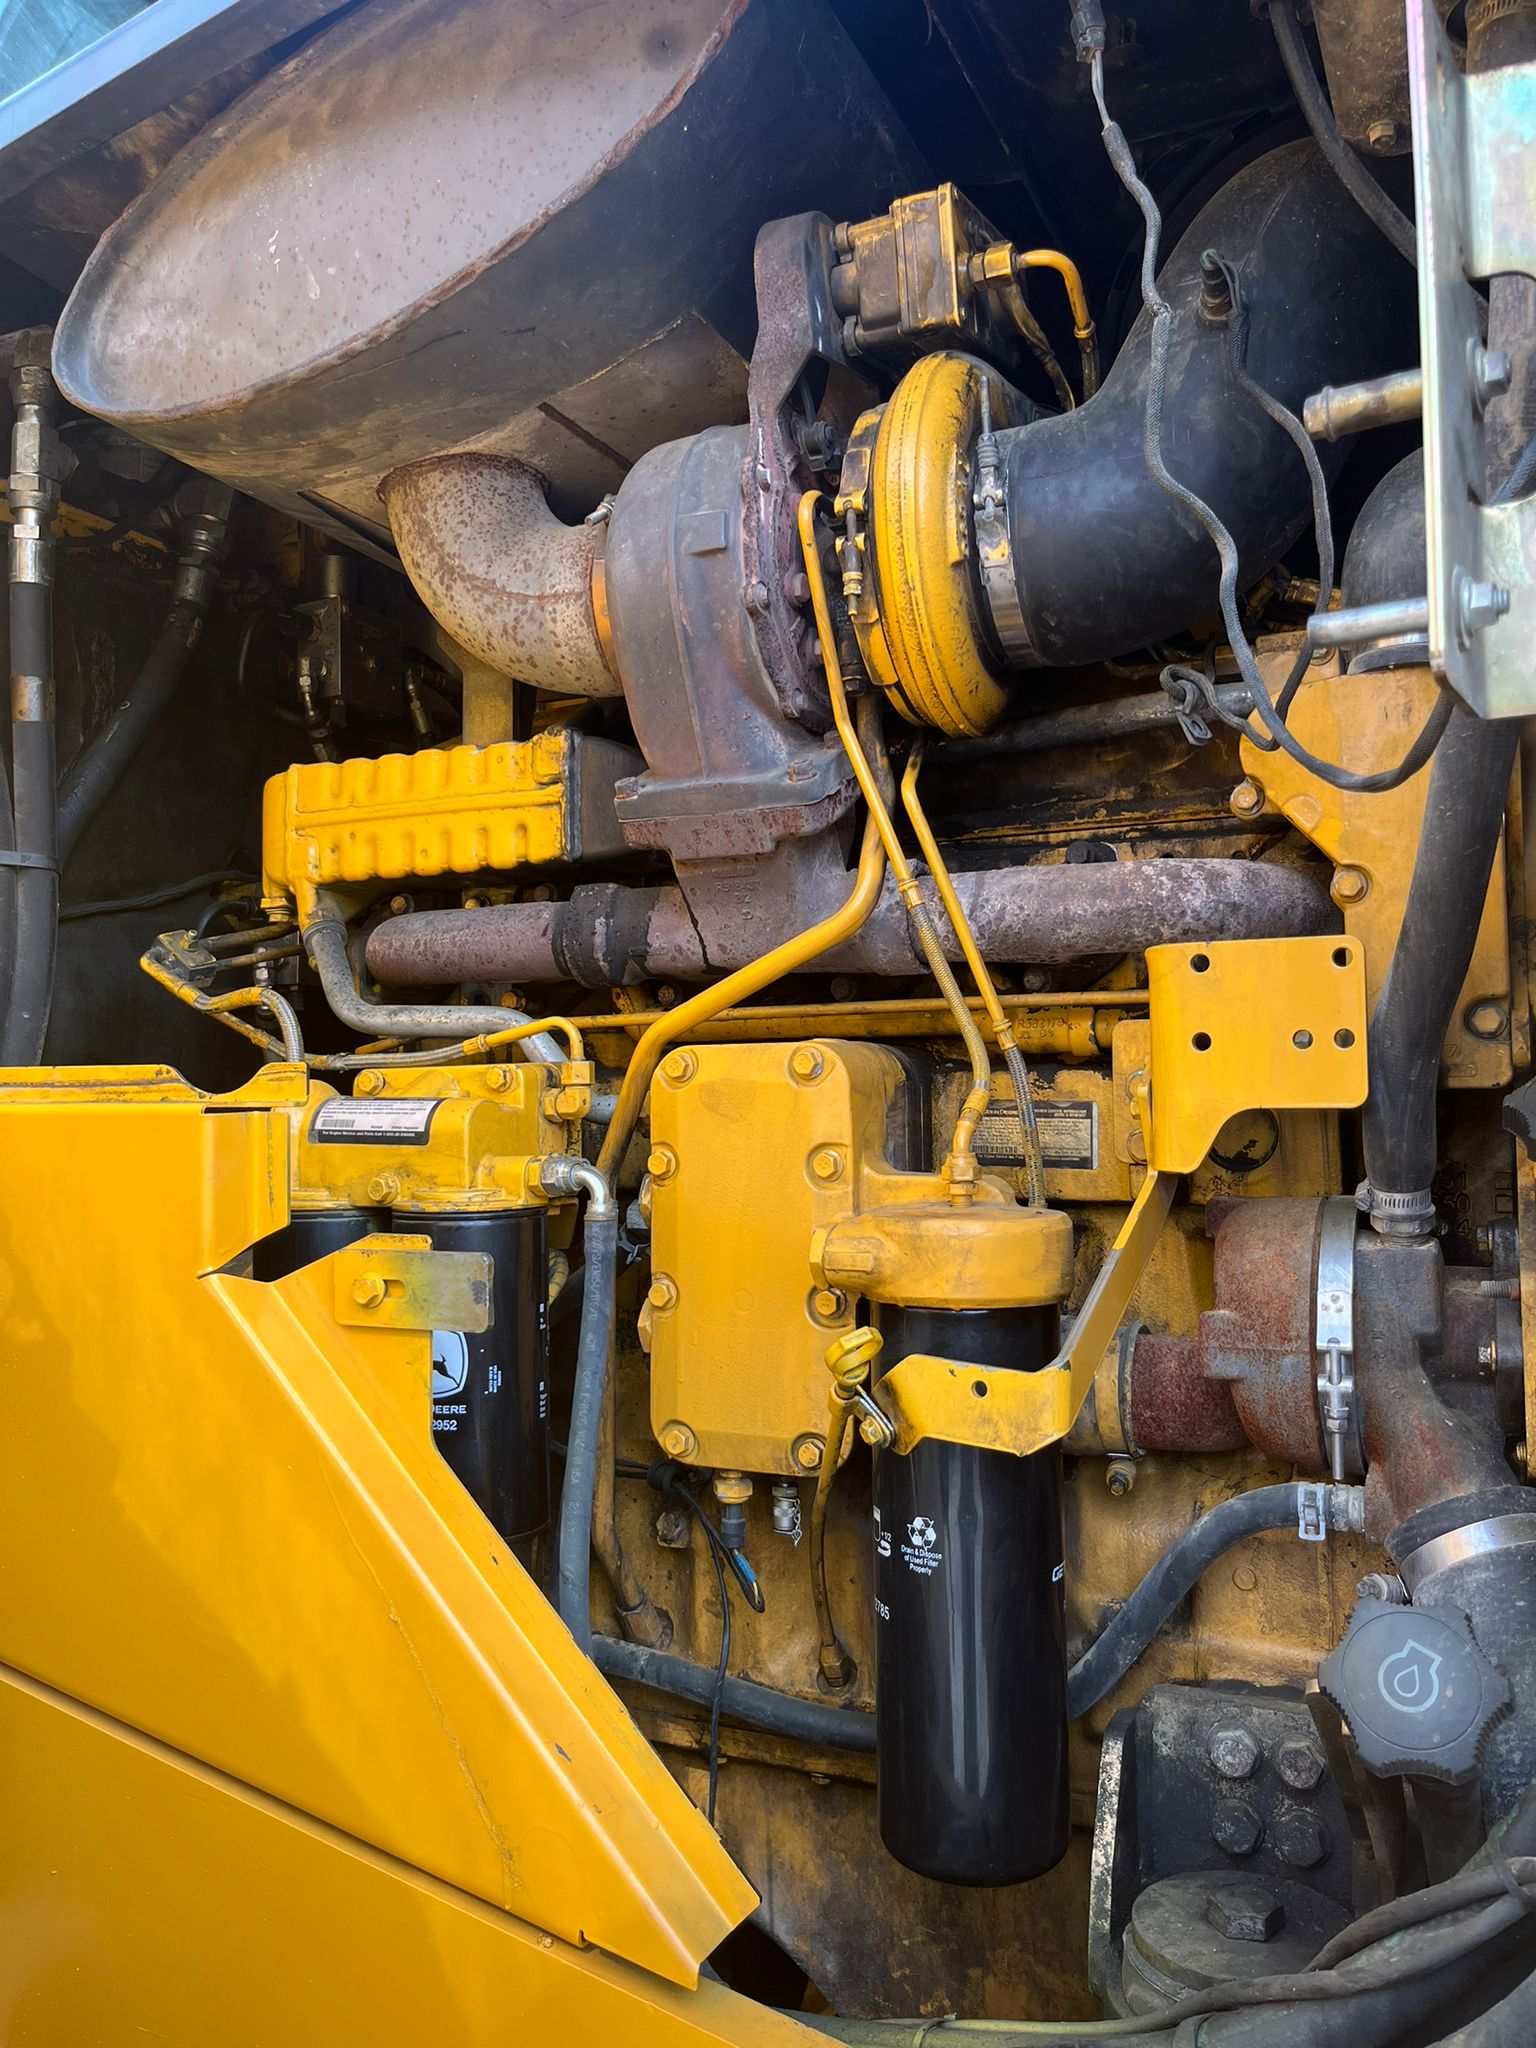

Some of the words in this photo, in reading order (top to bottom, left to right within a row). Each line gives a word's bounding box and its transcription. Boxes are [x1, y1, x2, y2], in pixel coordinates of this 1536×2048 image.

[901, 1544, 914, 1554] Drain
[919, 1549, 942, 1559] Dispose
[909, 1555, 923, 1565] Used
[924, 1558, 938, 1567] Filter
[909, 1562, 932, 1576] Properly
